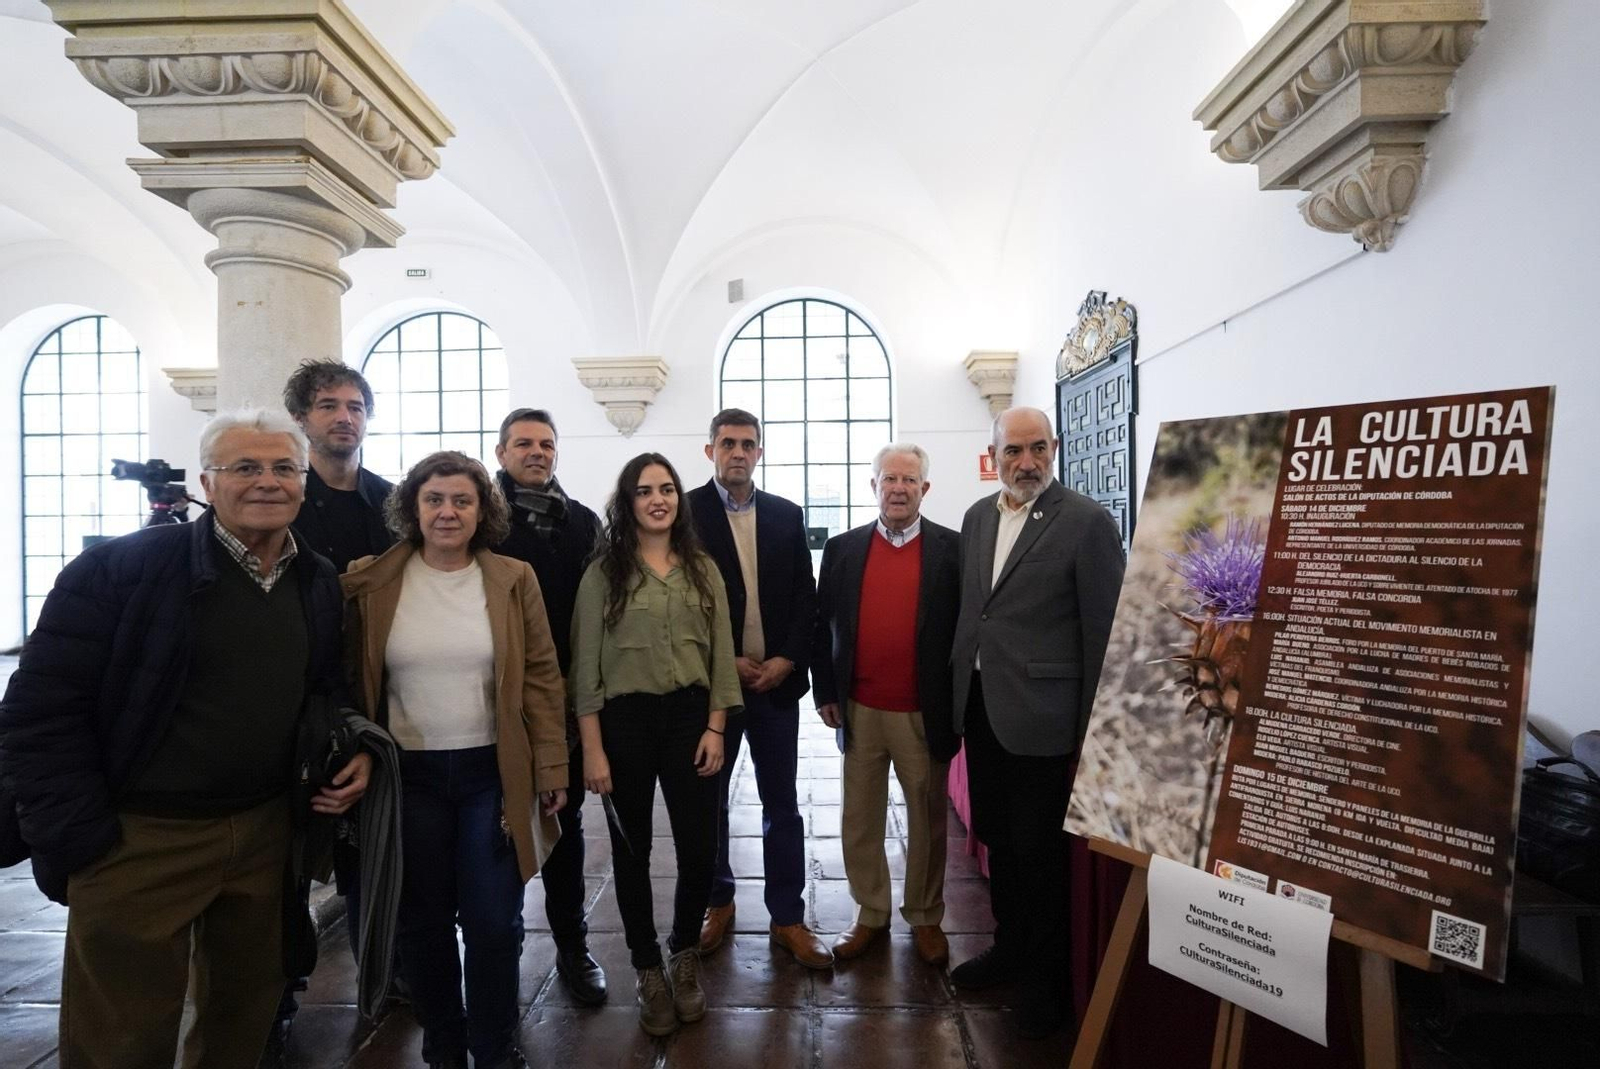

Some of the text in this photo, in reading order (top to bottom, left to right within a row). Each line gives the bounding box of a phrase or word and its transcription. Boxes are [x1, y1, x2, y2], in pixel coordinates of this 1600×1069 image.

[1294, 399, 1533, 448] LA CULTURA
[1287, 439, 1529, 482] SILENCIADA
[1305, 493, 1314, 501] DE
[1315, 493, 1336, 501] ACTOS
[1349, 492, 1358, 500] LA
[1359, 491, 1402, 500] DIPUTACIÓN
[1403, 491, 1414, 499] DE
[1415, 490, 1453, 499] CÓRDOBA
[1329, 504, 1367, 512] DICIEMBRE
[1274, 551, 1290, 559] 11:00
[1299, 552, 1312, 560] DEL
[1313, 552, 1343, 561] SILENCIO
[1344, 553, 1354, 562] DE
[1355, 554, 1365, 562] LA
[1366, 554, 1408, 564] DICTADURA
[1409, 555, 1419, 564] AL
[1421, 555, 1457, 565] SILENCIO
[1459, 556, 1470, 566] DE
[1472, 557, 1483, 566] LA
[1267, 587, 1284, 595] 12:30
[1293, 588, 1315, 597] FALSA
[1353, 592, 1377, 601] FALSA
[1378, 593, 1422, 604] CONCORDIA
[1287, 615, 1322, 625] SITUACIÓN
[1324, 618, 1351, 628] ACTUAL
[1353, 620, 1367, 629] DEL
[1369, 622, 1418, 634] MOVIMIENTO
[1419, 626, 1482, 640] MEMORIALISTA
[1485, 631, 1497, 641] EN
[1408, 646, 1420, 654] DEL
[1457, 651, 1478, 660] SANTA
[1370, 650, 1390, 659] LUCHA
[1392, 652, 1400, 660] DE
[1431, 656, 1439, 664] DE
[1501, 664, 1510, 673] DE
[1414, 688, 1427, 697] POR
[1428, 690, 1436, 698] LA
[1504, 682, 1509, 690] Y
[1270, 711, 1280, 720] LA
[1281, 713, 1312, 726] CULTURA
[1423, 707, 1432, 715] LA
[1404, 721, 1413, 729] DE
[1414, 723, 1423, 731] LA
[1233, 765, 1329, 794] DOMINGO 15 DE DICIEMBRE
[1378, 784, 1386, 793] LA
[1381, 810, 1389, 819] DE
[1391, 812, 1399, 821] LA
[1434, 822, 1443, 832] DE
[1445, 825, 1454, 835] LA
[1370, 817, 1374, 825] Y
[1446, 835, 1469, 850] MEDIA
[1264, 808, 1274, 817] DEL
[1303, 818, 1307, 826] A
[1309, 820, 1320, 829] LAS
[1365, 835, 1374, 844] LA
[1417, 848, 1447, 865] SITUADA
[1450, 856, 1472, 871] JUNTO
[1474, 863, 1480, 874] A
[1482, 865, 1492, 877] LA
[1297, 845, 1305, 853] SE
[1294, 834, 1304, 844] LAS
[1328, 843, 1336, 853] EN
[1337, 846, 1357, 859] SANTA
[1380, 858, 1390, 868] DE
[1308, 857, 1317, 866] EN
[1218, 890, 1245, 906] WIFI
[1190, 904, 1272, 942] Nombre de Red:
[1186, 914, 1276, 956] CulturaSilenciada
[1199, 942, 1261, 974] Contraseña:
